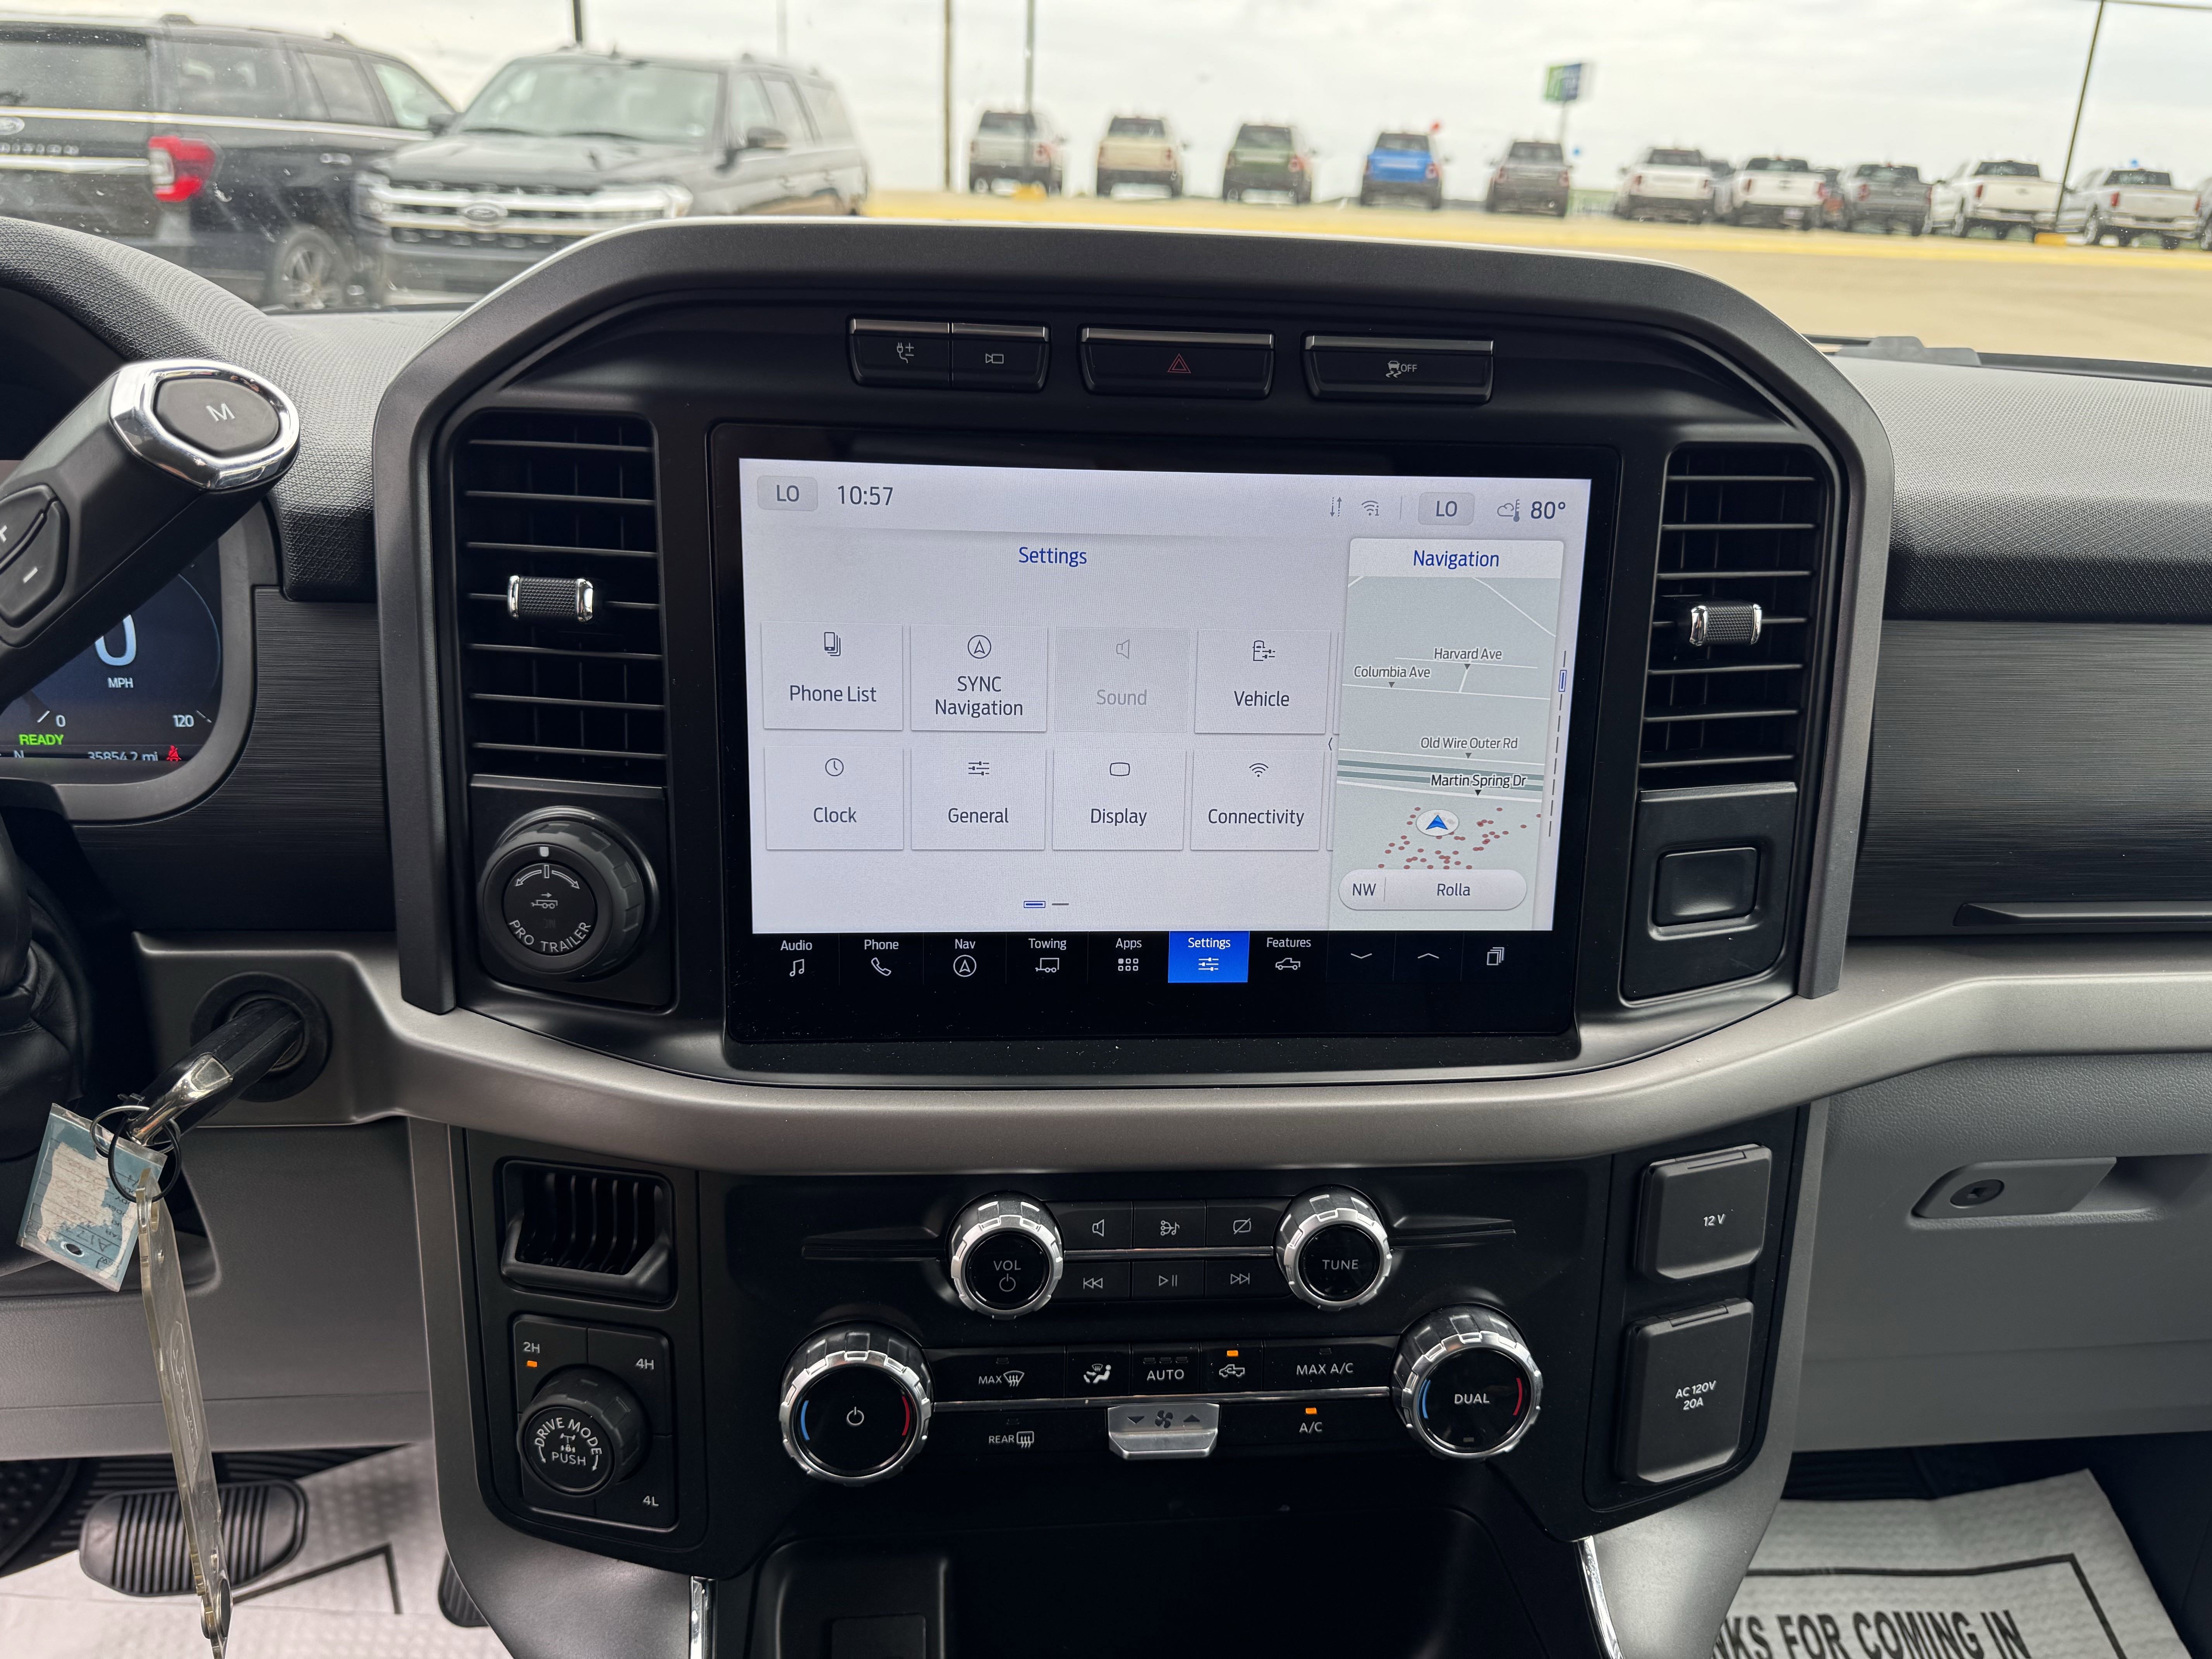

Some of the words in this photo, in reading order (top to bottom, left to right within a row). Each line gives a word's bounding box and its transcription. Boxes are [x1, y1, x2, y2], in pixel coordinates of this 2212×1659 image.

[1400, 364, 1418, 372] OFF
[206, 403, 235, 422] M
[776, 484, 800, 503] LO
[837, 485, 894, 505] 10:57
[1436, 500, 1458, 517] LO
[1530, 501, 1566, 520] 80°
[1018, 546, 1087, 568] Settings
[1413, 550, 1499, 570] Navigation
[1434, 647, 1479, 659] Harvard
[1480, 648, 1502, 659] Ave
[1354, 666, 1407, 678] Columbia
[1409, 666, 1431, 678] Ave
[108, 677, 134, 688] MPH
[957, 675, 1001, 692] SYNC
[790, 684, 843, 702] Phone
[848, 685, 877, 702] List
[1096, 689, 1147, 705] Sound
[1233, 690, 1290, 707] Vehicle
[935, 699, 1023, 718] Navigation
[55, 714, 66, 727] 0
[173, 714, 194, 728] 120
[19, 734, 64, 745] READY
[1420, 737, 1440, 749] Old
[1442, 737, 1467, 749] Wire
[1469, 737, 1500, 749] Outer
[1503, 737, 1518, 749] Rd
[141, 751, 158, 761] mi
[1431, 775, 1469, 786] Martin
[1472, 775, 1510, 788] Spring
[1512, 775, 1526, 787] Dr
[813, 807, 857, 823] Clock
[948, 807, 1009, 824] General
[1090, 808, 1147, 826] Display
[1207, 809, 1305, 827] Connectivity
[1352, 883, 1376, 896] NW
[1436, 883, 1470, 896] Rolla
[508, 920, 534, 945] PRO
[540, 922, 592, 953] TRAILER
[1266, 937, 1312, 948] Features
[780, 939, 813, 951] Audio
[864, 939, 899, 950] Phone
[954, 938, 976, 950] Nav
[1028, 938, 1067, 950] Towing
[1115, 938, 1142, 950] Apps
[1187, 937, 1231, 950] Settings
[1704, 1215, 1716, 1227] 12
[1717, 1213, 1726, 1224] V
[993, 1259, 1021, 1271] VOL
[1322, 1259, 1359, 1270] TUNE
[523, 1341, 540, 1354] 2H
[635, 1358, 654, 1370] 4H
[1296, 1364, 1326, 1376] MAX
[1330, 1362, 1354, 1375] A/C
[978, 1375, 1003, 1386] MAX
[1146, 1369, 1185, 1381] AUTO
[1675, 1387, 1690, 1399] AC
[1692, 1380, 1717, 1395] 120V
[1453, 1393, 1490, 1405] DUAL
[1683, 1396, 1704, 1410] 20A
[1298, 1422, 1323, 1434] A/C
[534, 1417, 565, 1448] DRIVE
[567, 1418, 603, 1456] MODE
[988, 1434, 1015, 1445] REAR
[551, 1451, 586, 1467] PUSH
[642, 1495, 659, 1508] 4L
[1776, 1613, 1853, 1659] FOR
[1851, 1610, 1985, 1659] COMING
[1980, 1609, 2032, 1659] IN
